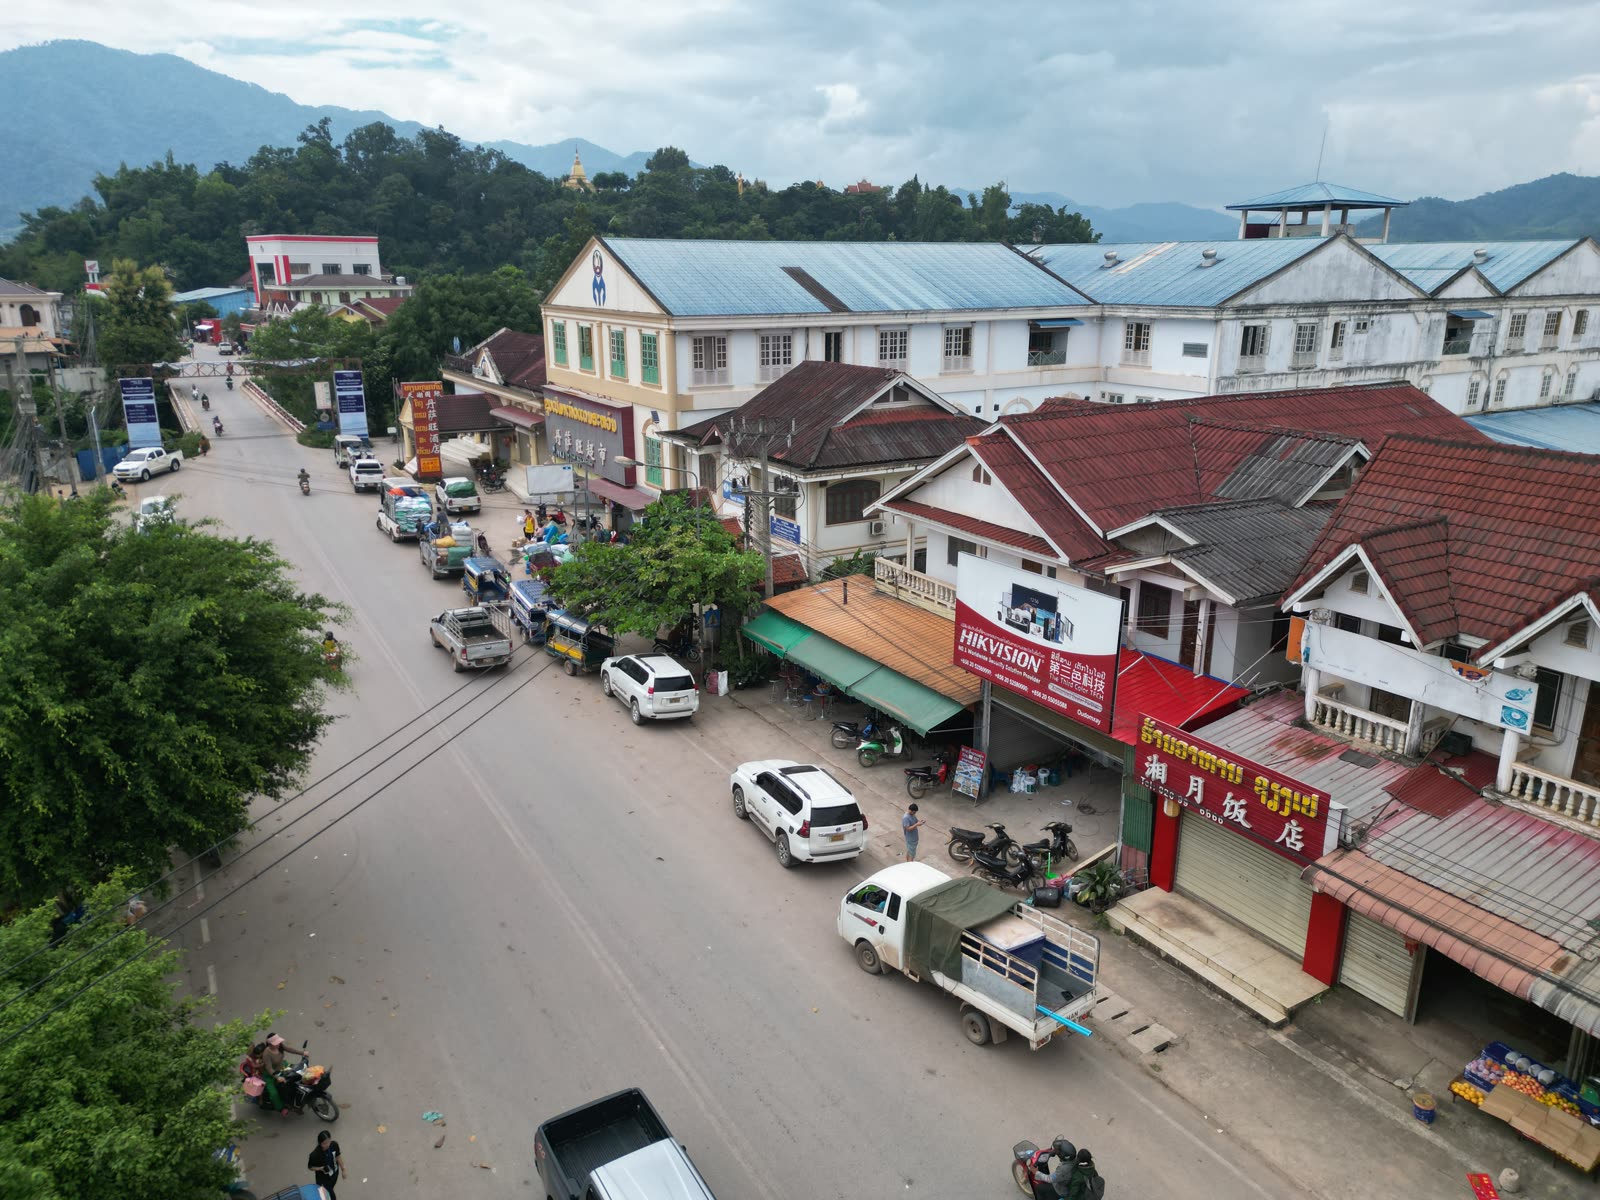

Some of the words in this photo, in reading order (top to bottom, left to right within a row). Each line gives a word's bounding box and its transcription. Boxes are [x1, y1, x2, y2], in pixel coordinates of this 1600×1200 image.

[426, 399, 440, 454] 丹萨旺酒店
[959, 628, 1041, 673] HIKVISION
[1022, 671, 1041, 684] Provider
[1049, 659, 1106, 695] 第三色科技
[1049, 672, 1059, 682] The
[1060, 677, 1074, 688] Third
[1074, 683, 1088, 693] Color
[1089, 689, 1104, 701] TECH
[1076, 708, 1101, 726] Oudomxay
[1144, 753, 1305, 852] 湘月饭店
